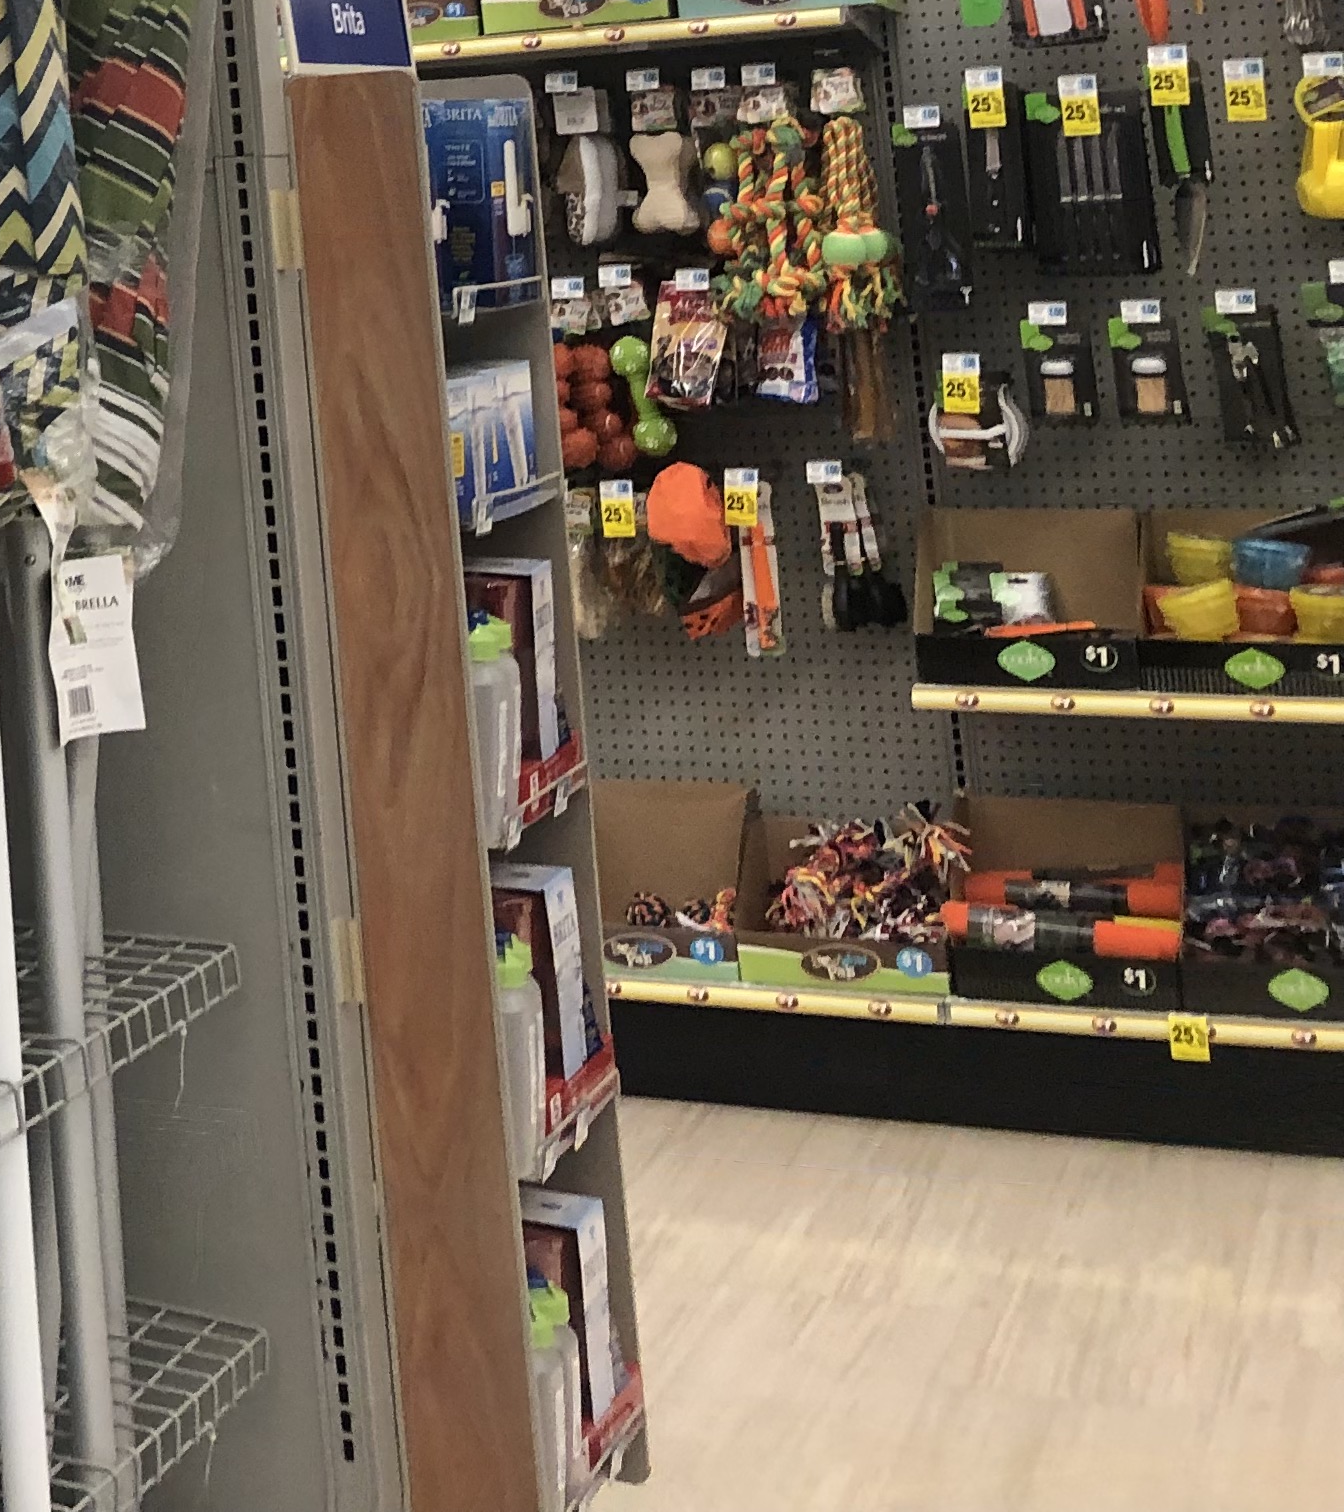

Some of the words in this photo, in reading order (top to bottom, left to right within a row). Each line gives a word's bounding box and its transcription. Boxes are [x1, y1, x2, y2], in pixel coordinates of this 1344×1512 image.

[330, 1, 367, 37] Brita
[1152, 75, 1175, 91] 25
[971, 97, 992, 114] 25
[1228, 89, 1252, 107] 25
[1064, 104, 1087, 121] 25
[945, 380, 967, 398] 25
[726, 494, 746, 511] 25
[603, 506, 623, 523] 25
[1084, 644, 1109, 668] $1
[1315, 652, 1341, 676] $1
[694, 938, 716, 960] $1
[1122, 967, 1147, 992] $1
